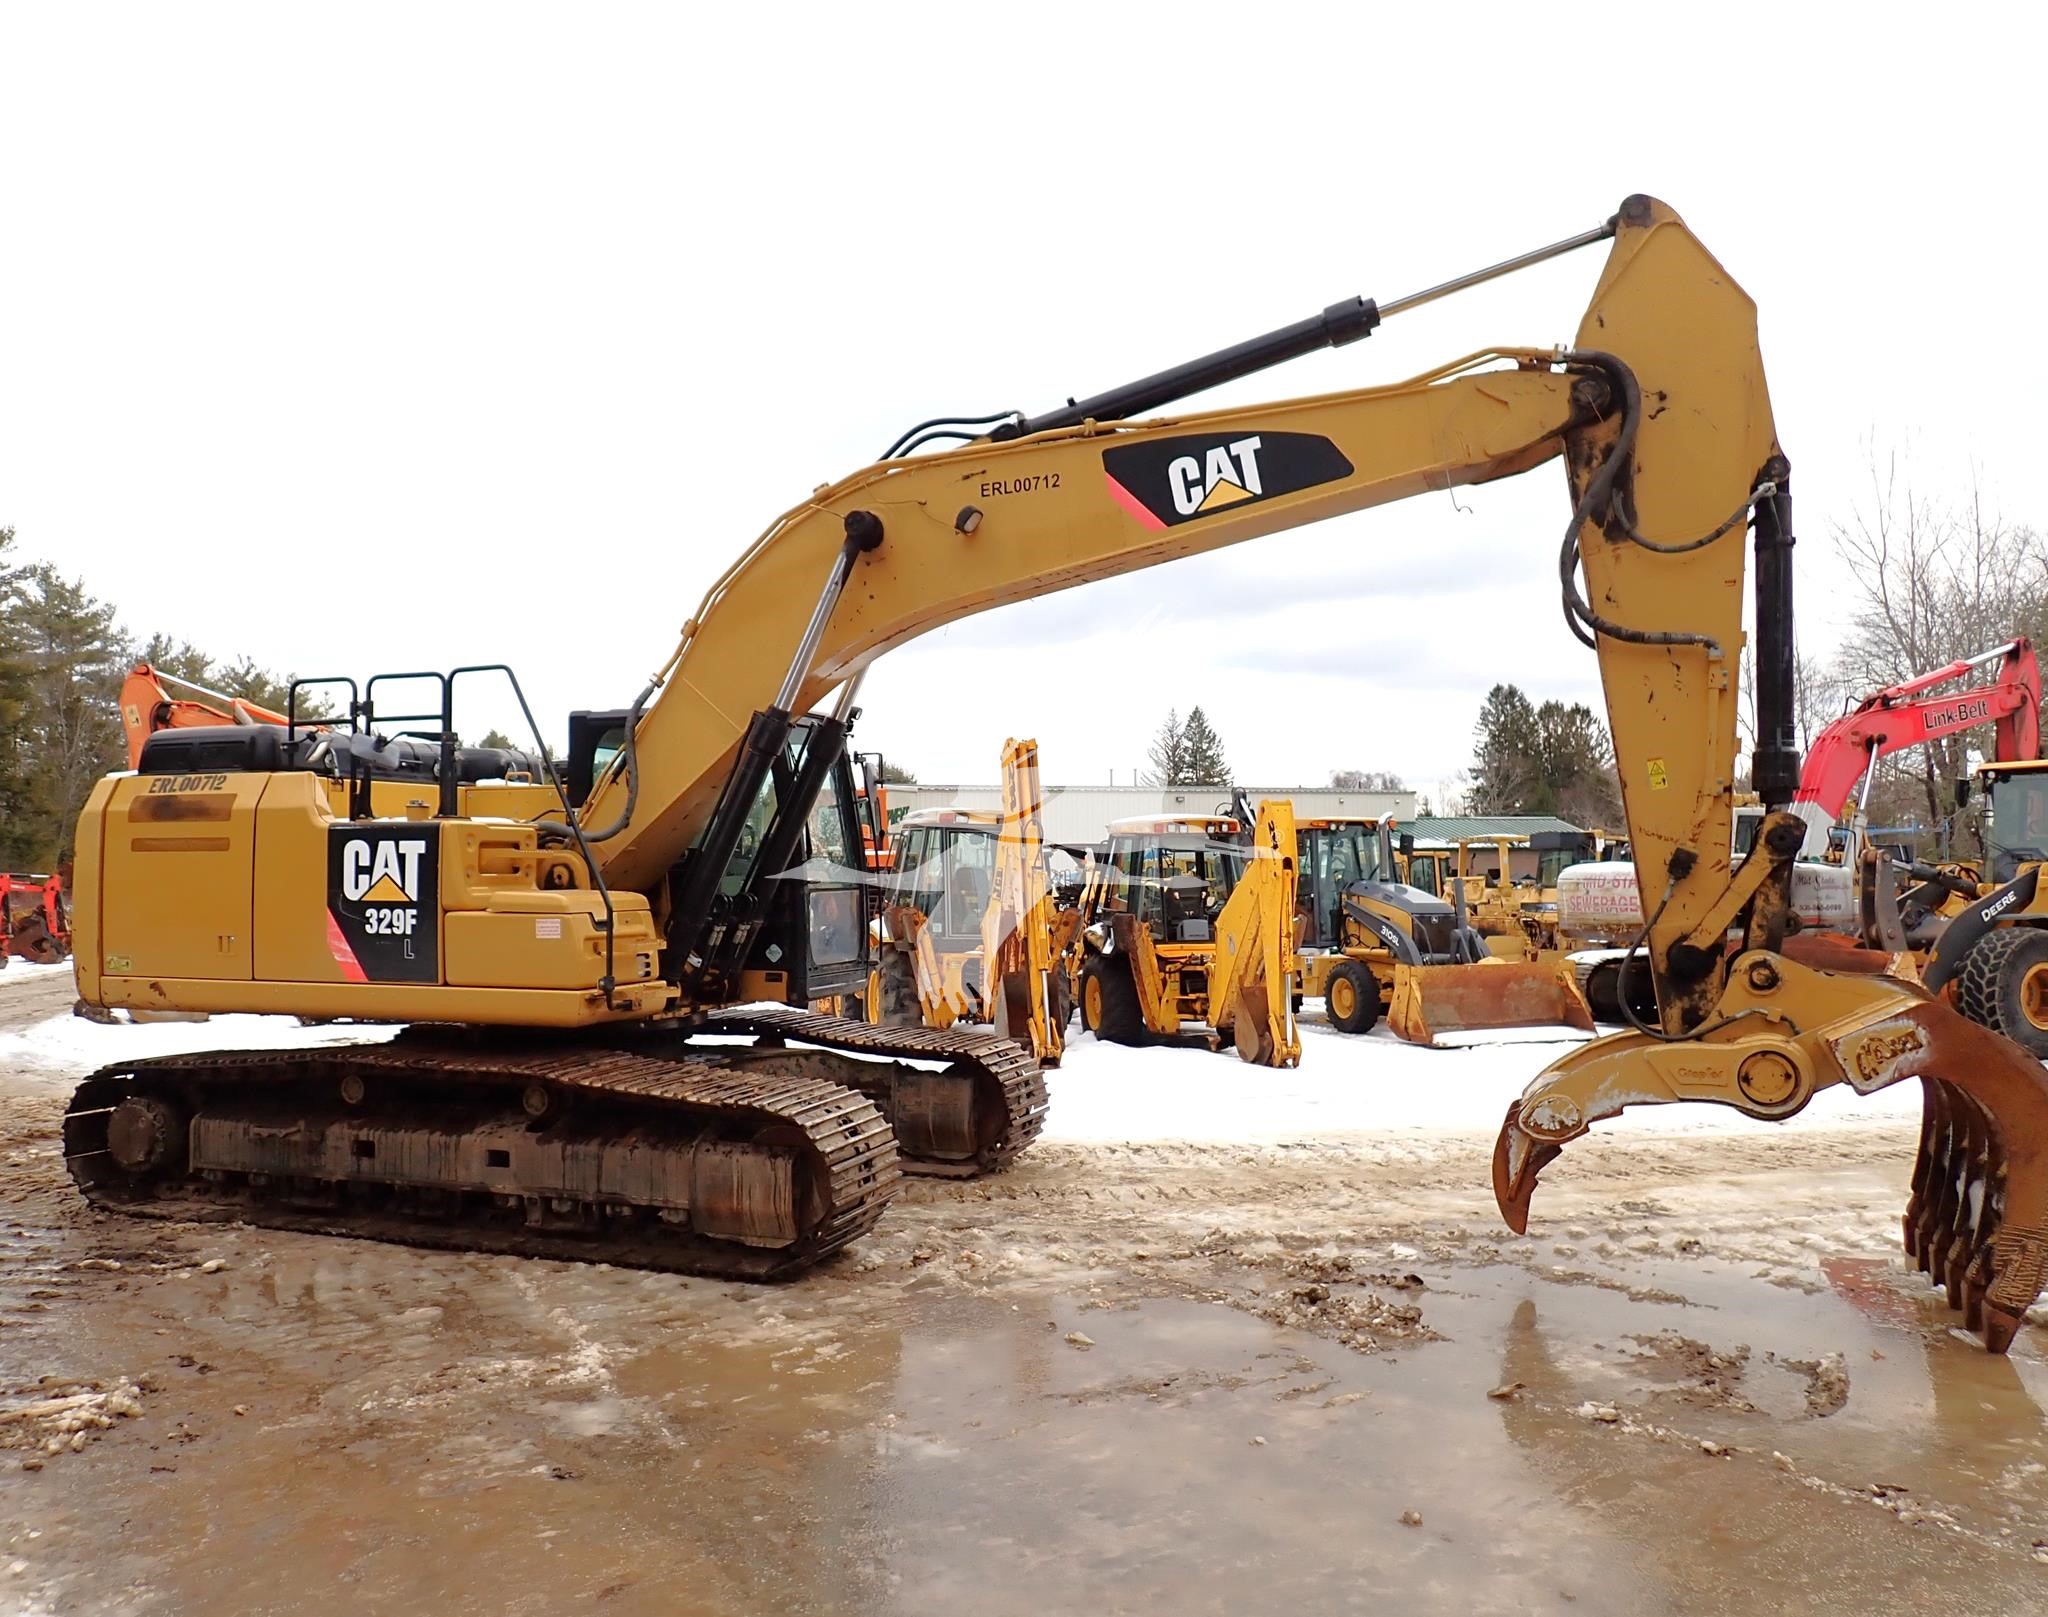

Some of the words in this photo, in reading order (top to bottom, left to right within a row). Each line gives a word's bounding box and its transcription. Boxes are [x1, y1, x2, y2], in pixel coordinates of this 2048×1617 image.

[980, 473, 1060, 498] ERL00712
[1168, 435, 1262, 515] CAT
[148, 774, 227, 794] ERL00712
[343, 839, 426, 902] CAT
[1981, 890, 2017, 922] DEERE
[364, 908, 418, 935] 329F
[404, 938, 415, 959] L
[1380, 925, 1400, 947] 310SL
